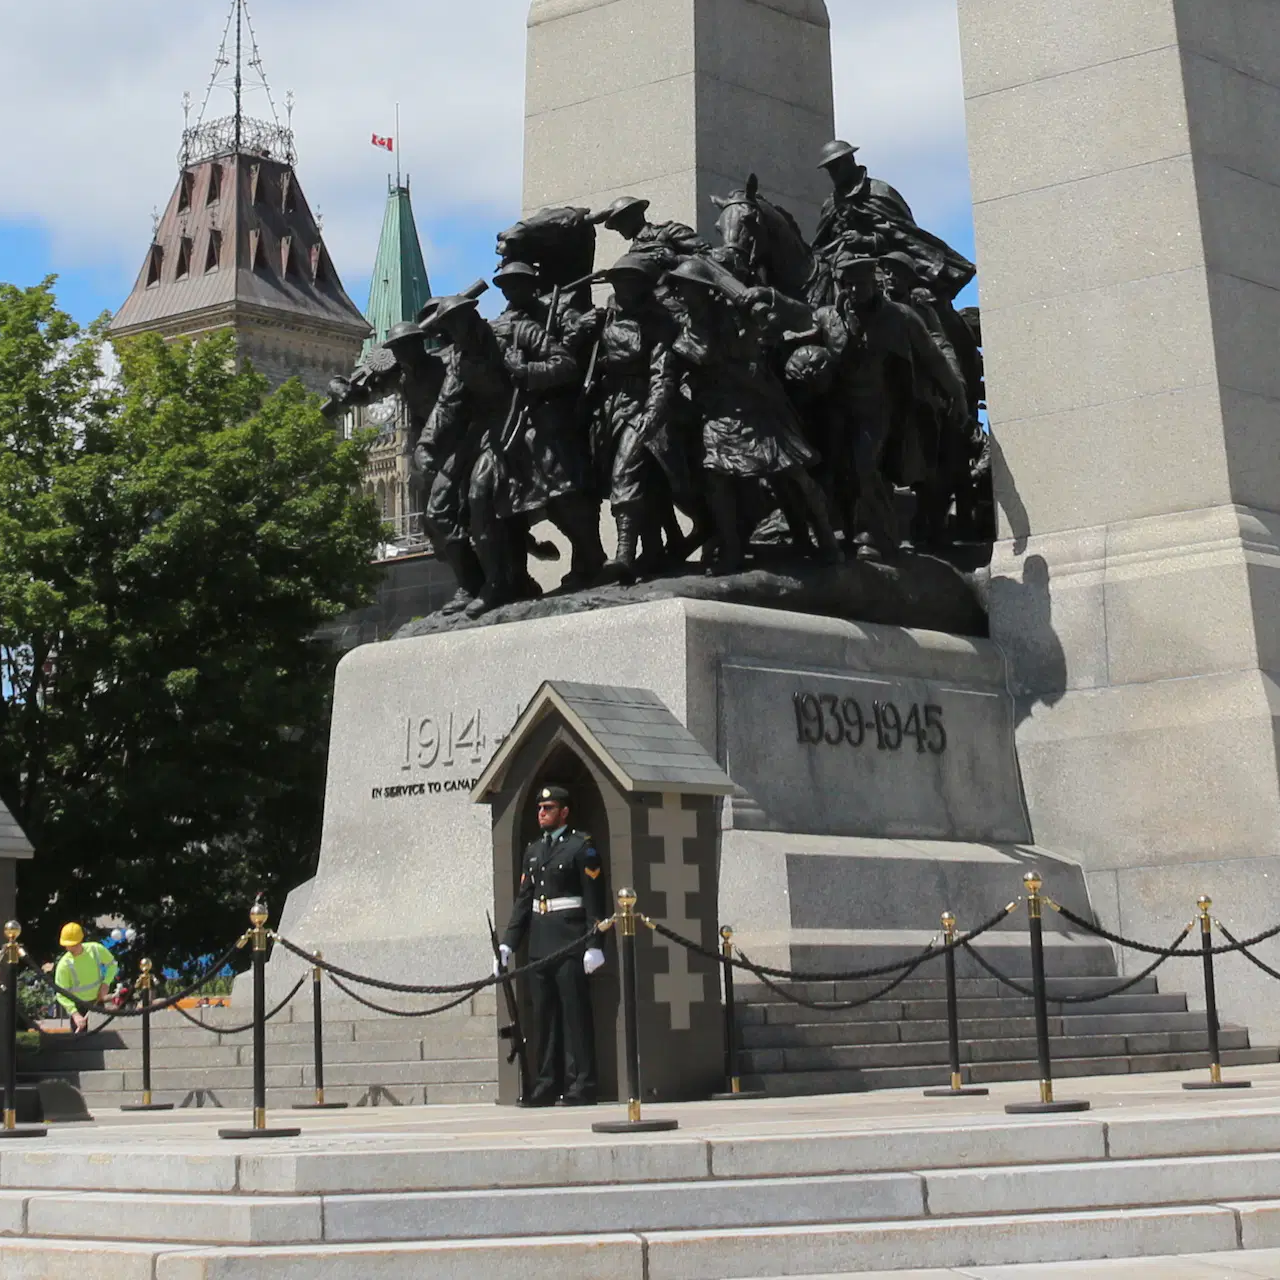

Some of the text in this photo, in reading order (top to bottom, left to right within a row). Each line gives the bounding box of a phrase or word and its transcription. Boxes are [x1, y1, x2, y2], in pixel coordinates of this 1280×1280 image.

[792, 691, 947, 755] 1939-1945
[372, 778, 478, 799] IN SERVICE TO CANAD
